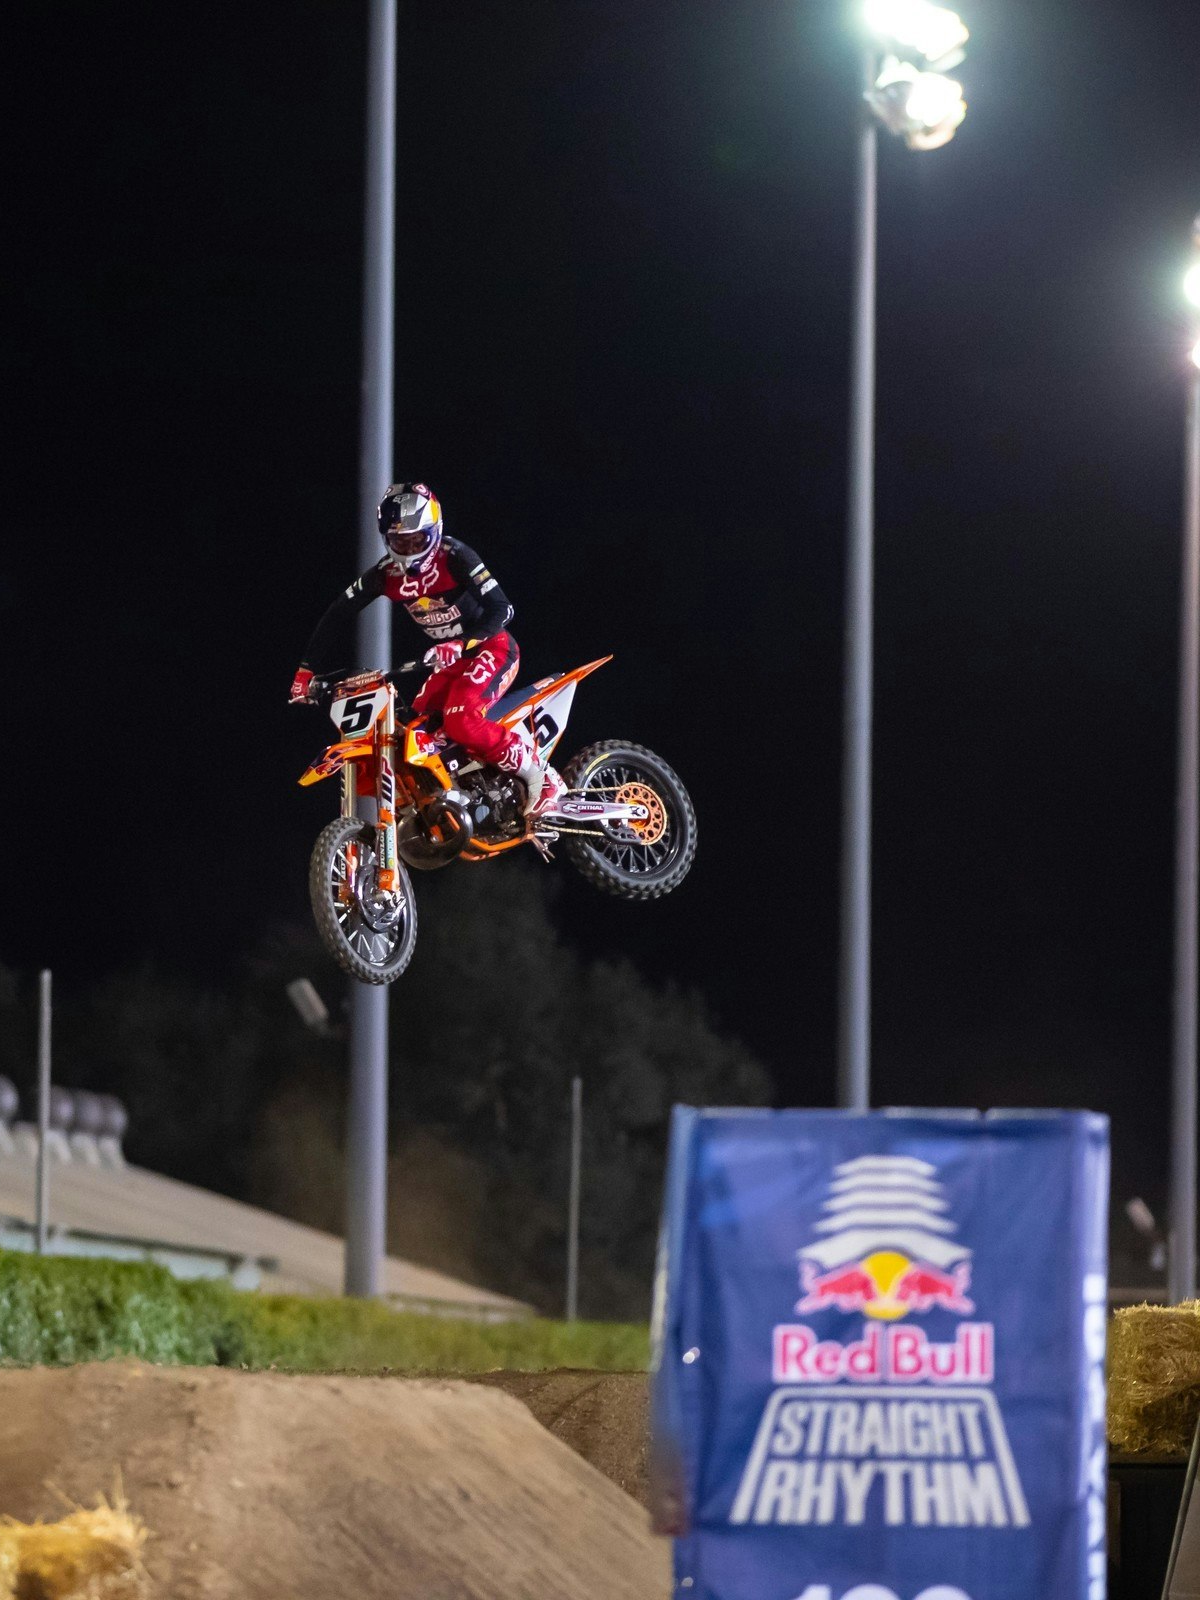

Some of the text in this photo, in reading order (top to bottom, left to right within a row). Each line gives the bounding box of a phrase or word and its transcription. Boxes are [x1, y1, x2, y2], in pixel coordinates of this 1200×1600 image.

[340, 692, 377, 734] 5
[523, 706, 559, 748] 5
[776, 1328, 990, 1380] Red Bull
[772, 1402, 987, 1457] STRAIGHT
[753, 1460, 1007, 1525] RHYTHM
